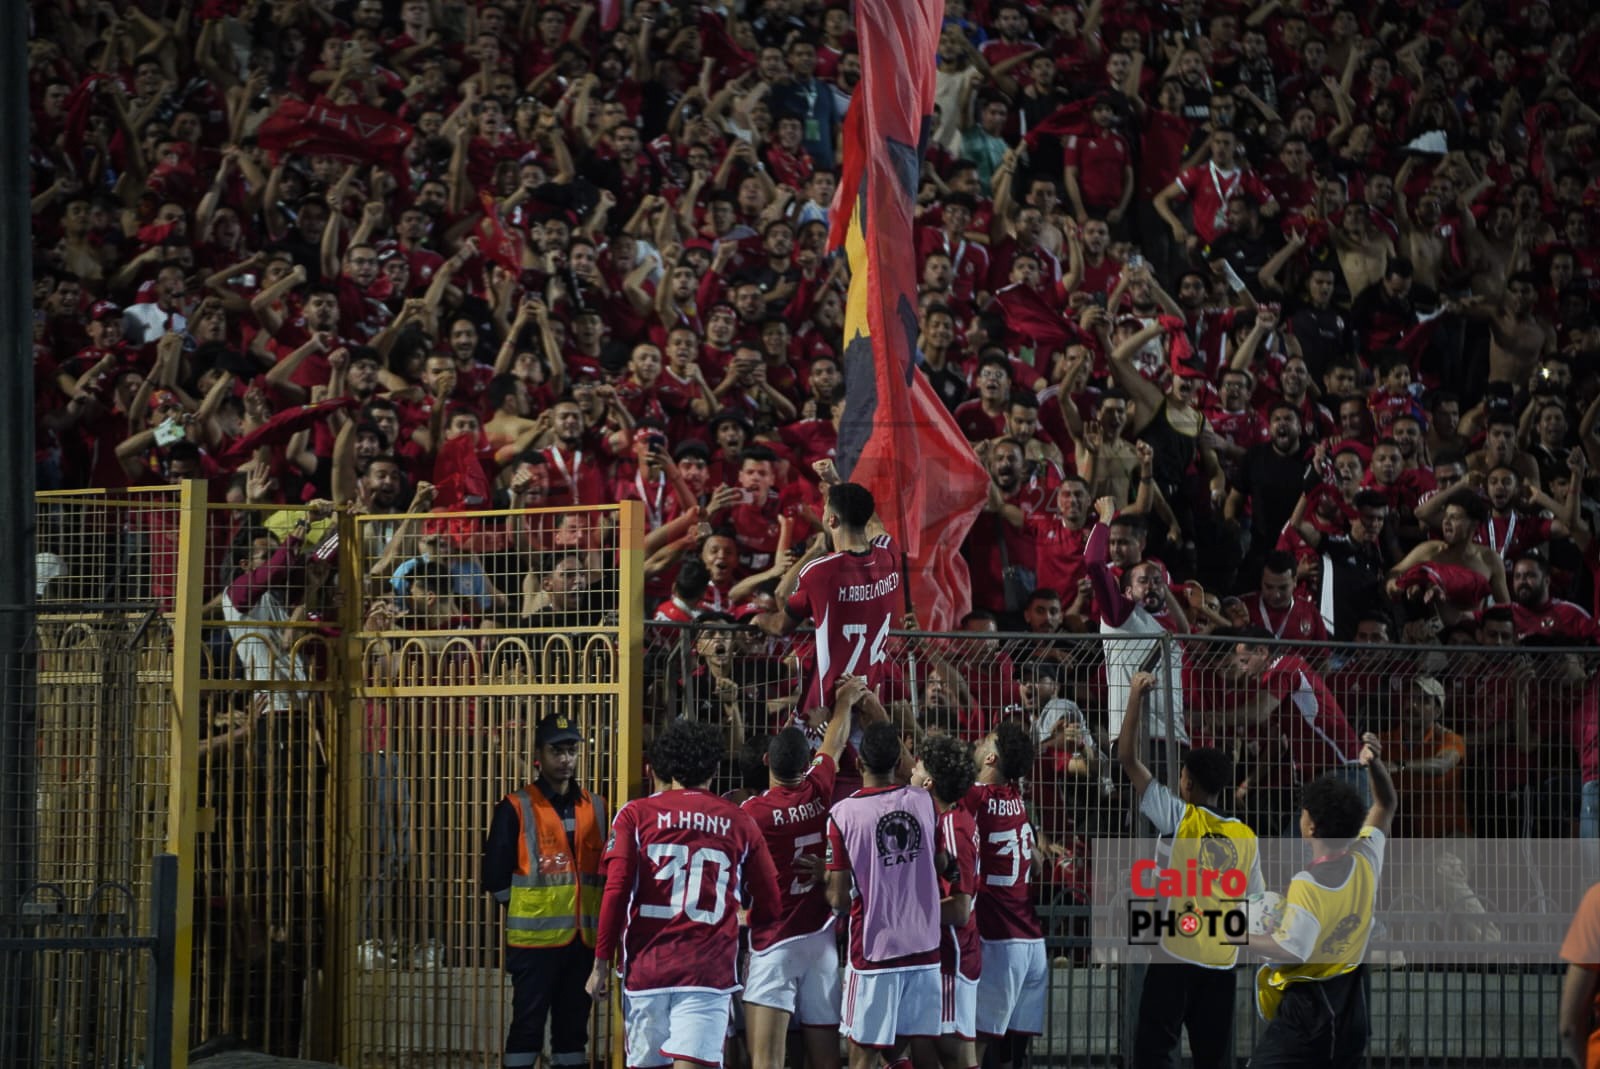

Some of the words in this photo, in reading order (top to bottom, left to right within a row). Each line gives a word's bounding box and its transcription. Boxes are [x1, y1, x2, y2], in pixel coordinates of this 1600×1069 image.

[656, 810, 732, 836] M.HANY
[884, 851, 920, 866] CAF
[639, 843, 732, 926] 30
